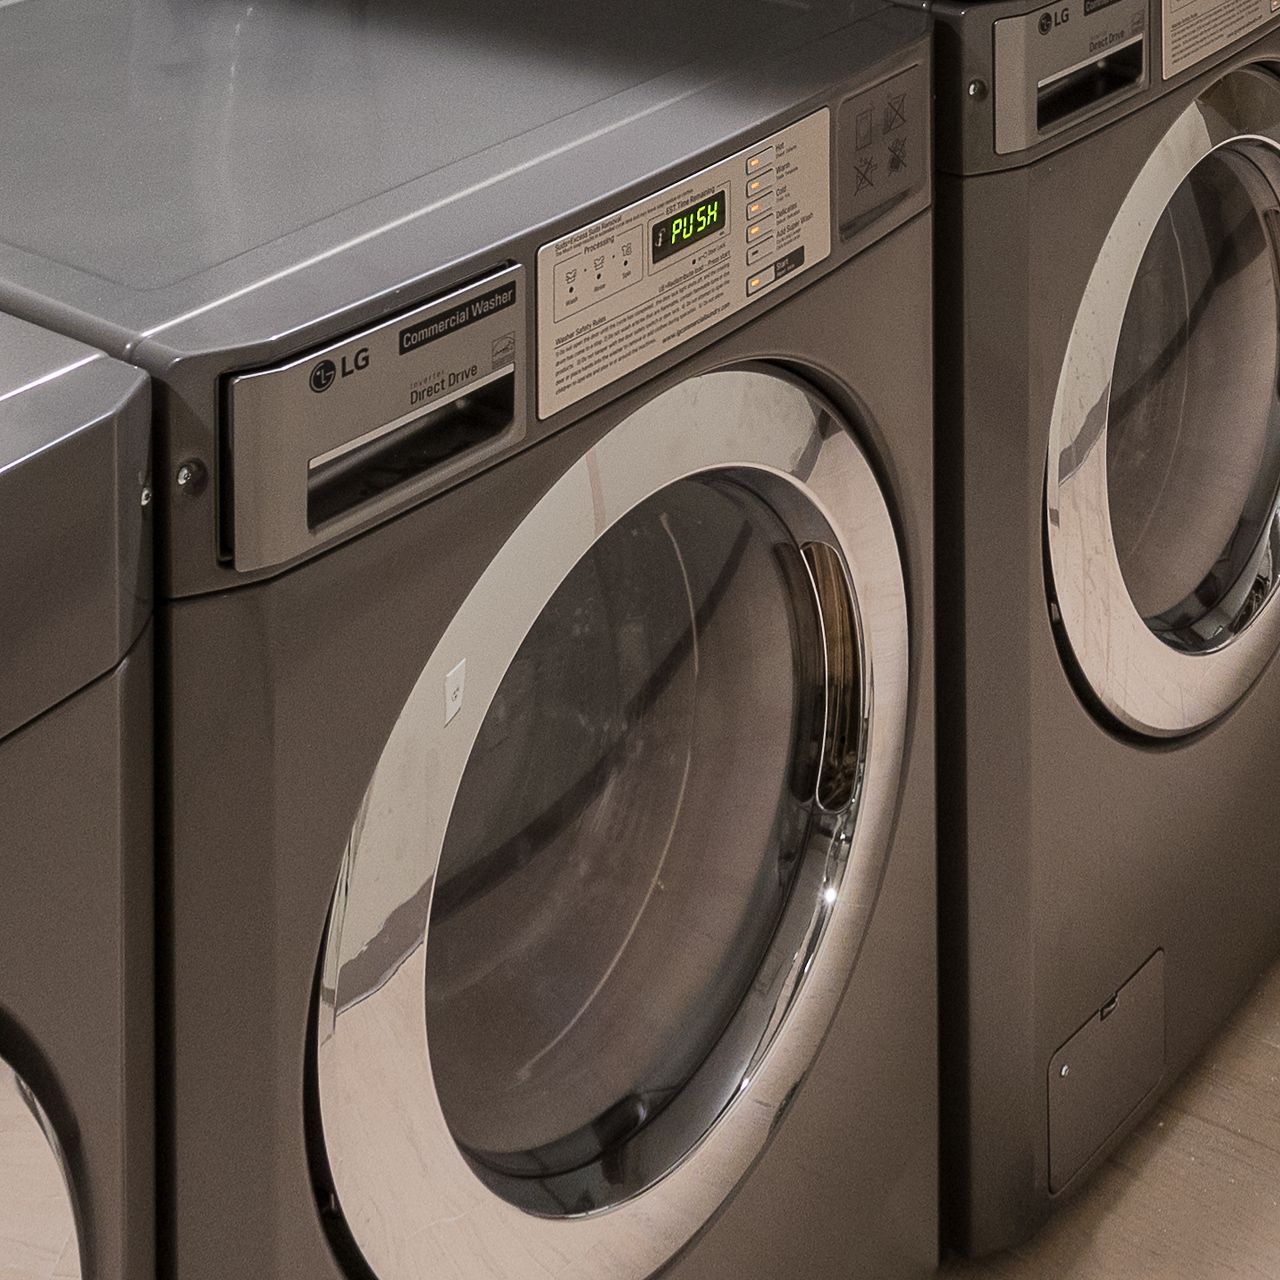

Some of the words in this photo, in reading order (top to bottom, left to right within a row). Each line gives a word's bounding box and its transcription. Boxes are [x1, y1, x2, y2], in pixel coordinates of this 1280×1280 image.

[1054, 7, 1070, 27] LG
[671, 201, 718, 245] PUSH
[402, 308, 469, 349] Commercial
[471, 288, 514, 317] Washer
[341, 347, 370, 379] LG
[410, 378, 445, 406] Direct
[448, 364, 478, 388] Drive
